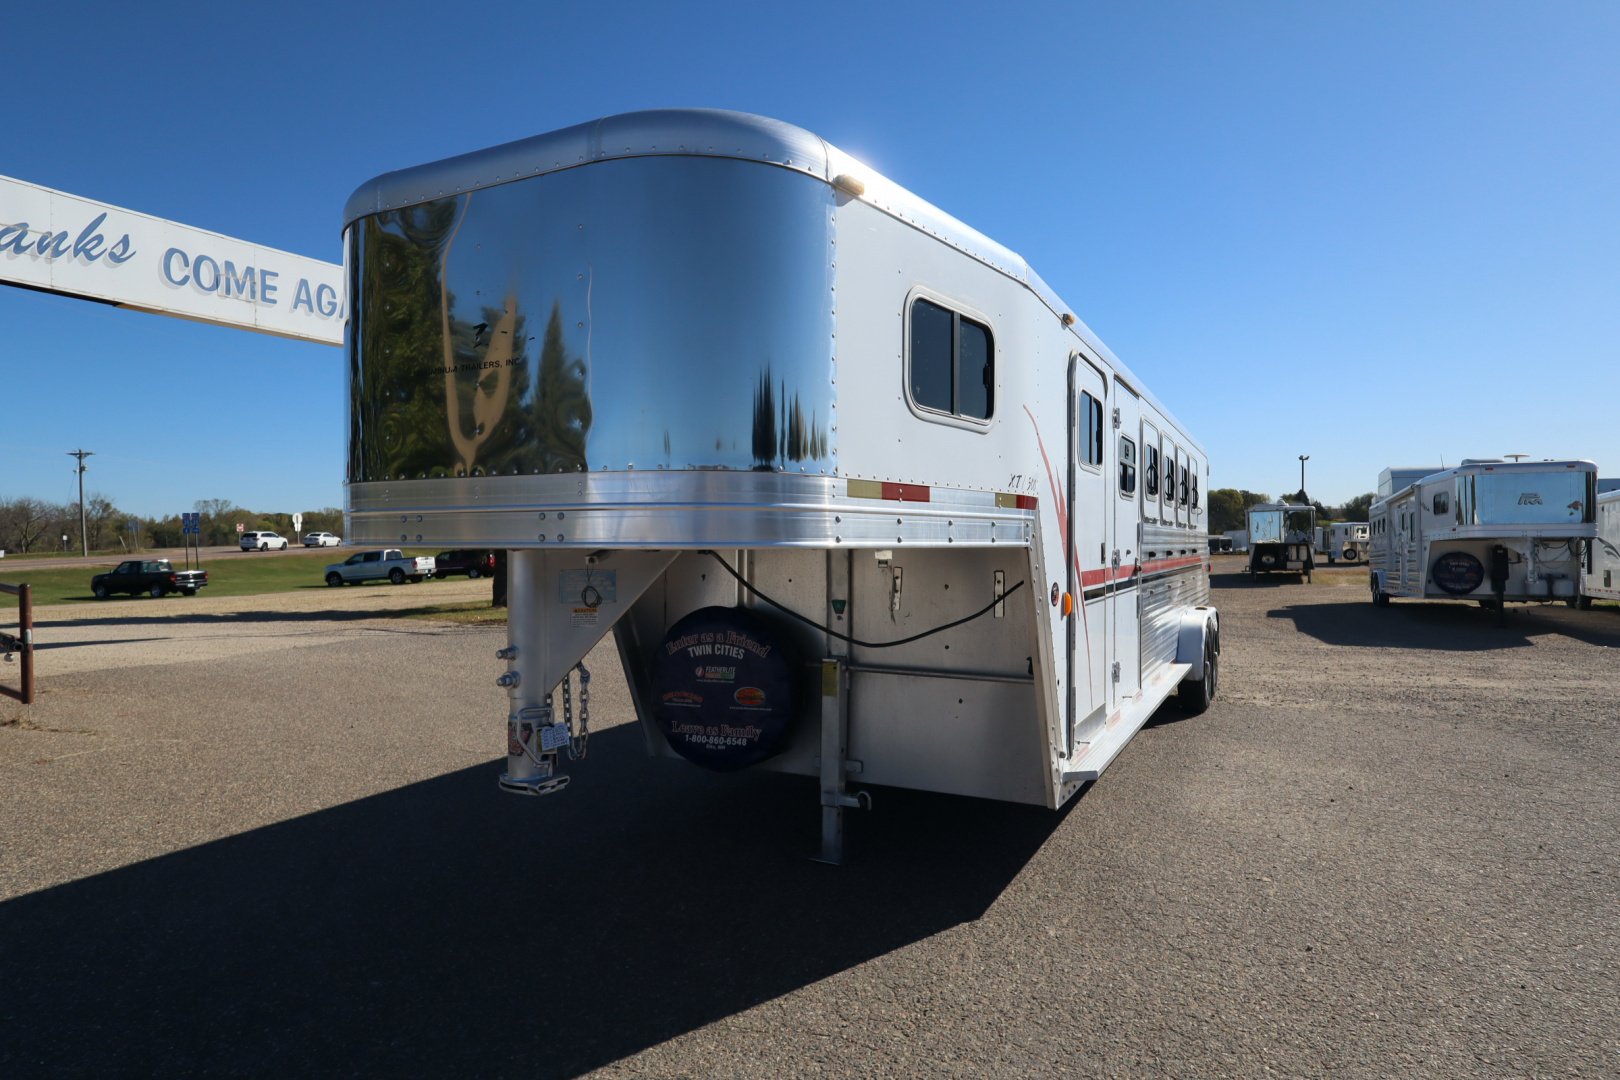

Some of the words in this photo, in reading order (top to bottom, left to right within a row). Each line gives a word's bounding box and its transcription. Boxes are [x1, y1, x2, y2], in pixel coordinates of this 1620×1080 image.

[162, 247, 279, 305] COME
[666, 634, 698, 655] Enter
[701, 632, 714, 642] as
[716, 632, 724, 642] a
[726, 630, 771, 658] Friend
[688, 644, 712, 657] TWIN
[714, 643, 745, 660] CITIES
[705, 666, 736, 674] FEATHERLITE
[671, 721, 704, 734] Leave
[706, 726, 719, 735] as
[720, 723, 762, 741] Family
[685, 734, 747, 746] 1-800-860-6548
